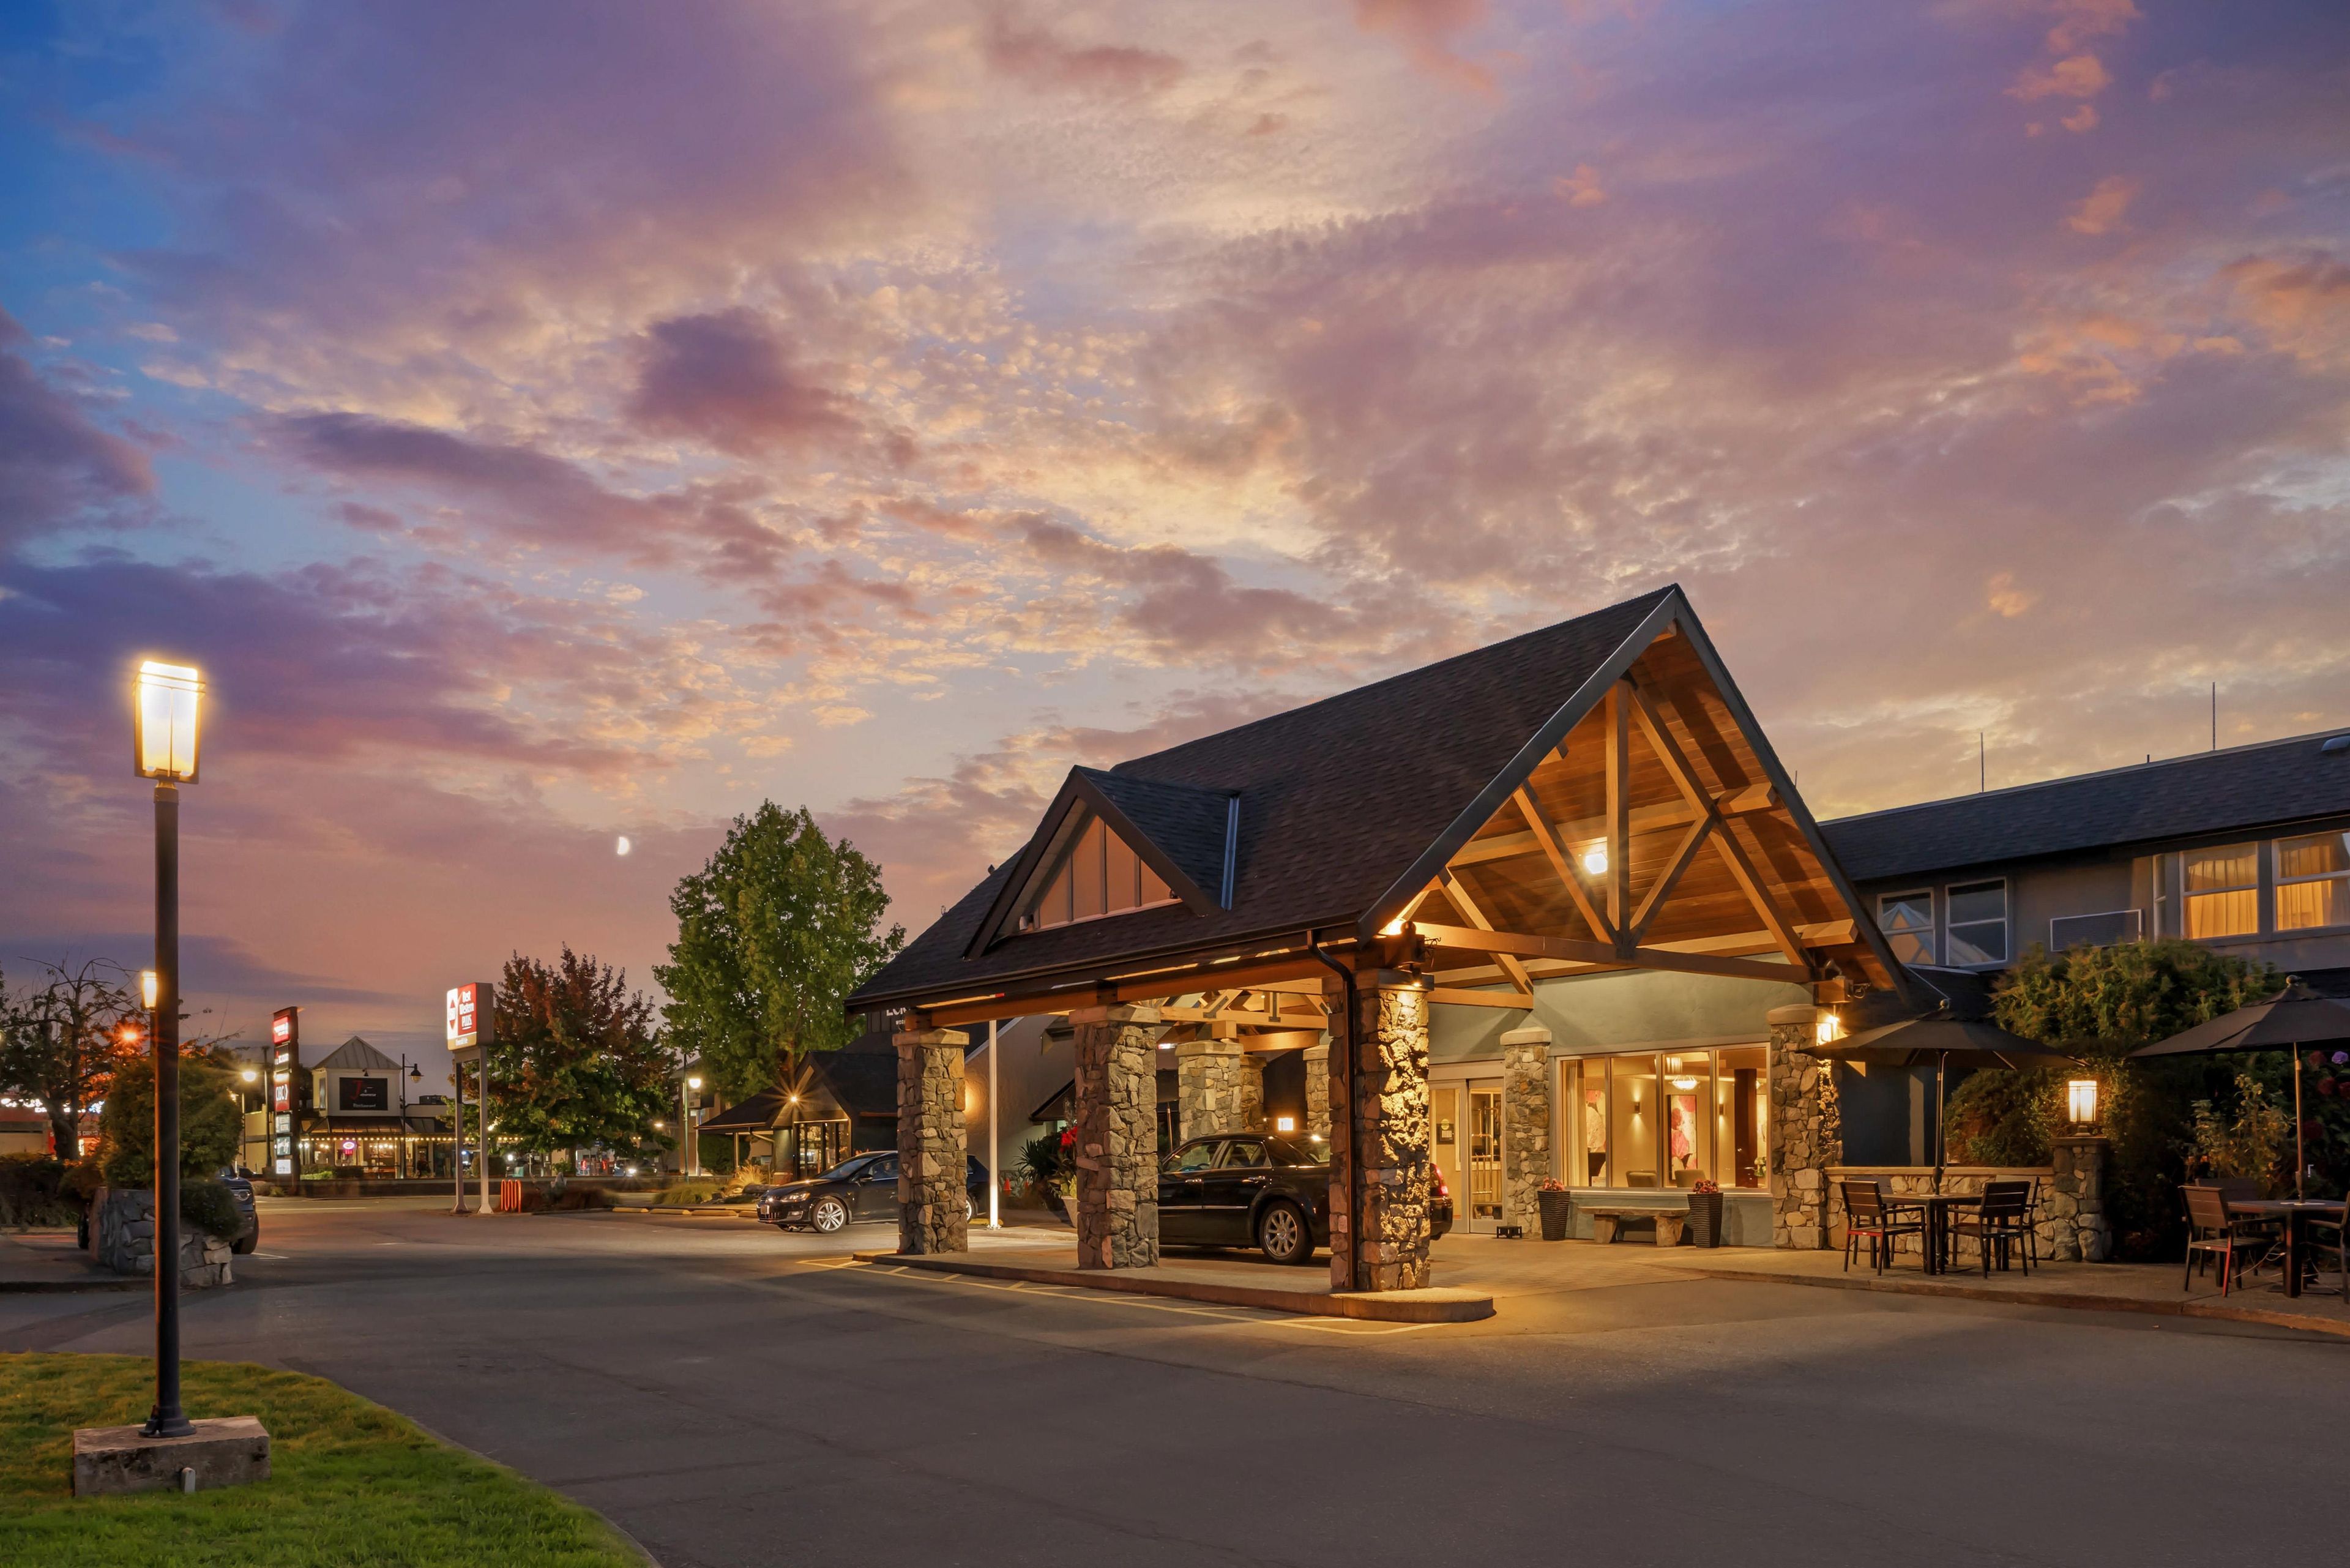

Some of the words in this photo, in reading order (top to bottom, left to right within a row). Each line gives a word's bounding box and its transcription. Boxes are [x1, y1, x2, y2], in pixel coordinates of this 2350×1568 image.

[462, 991, 471, 1002] Best
[459, 1002, 474, 1015] Western
[461, 1015, 472, 1027] PLUS
